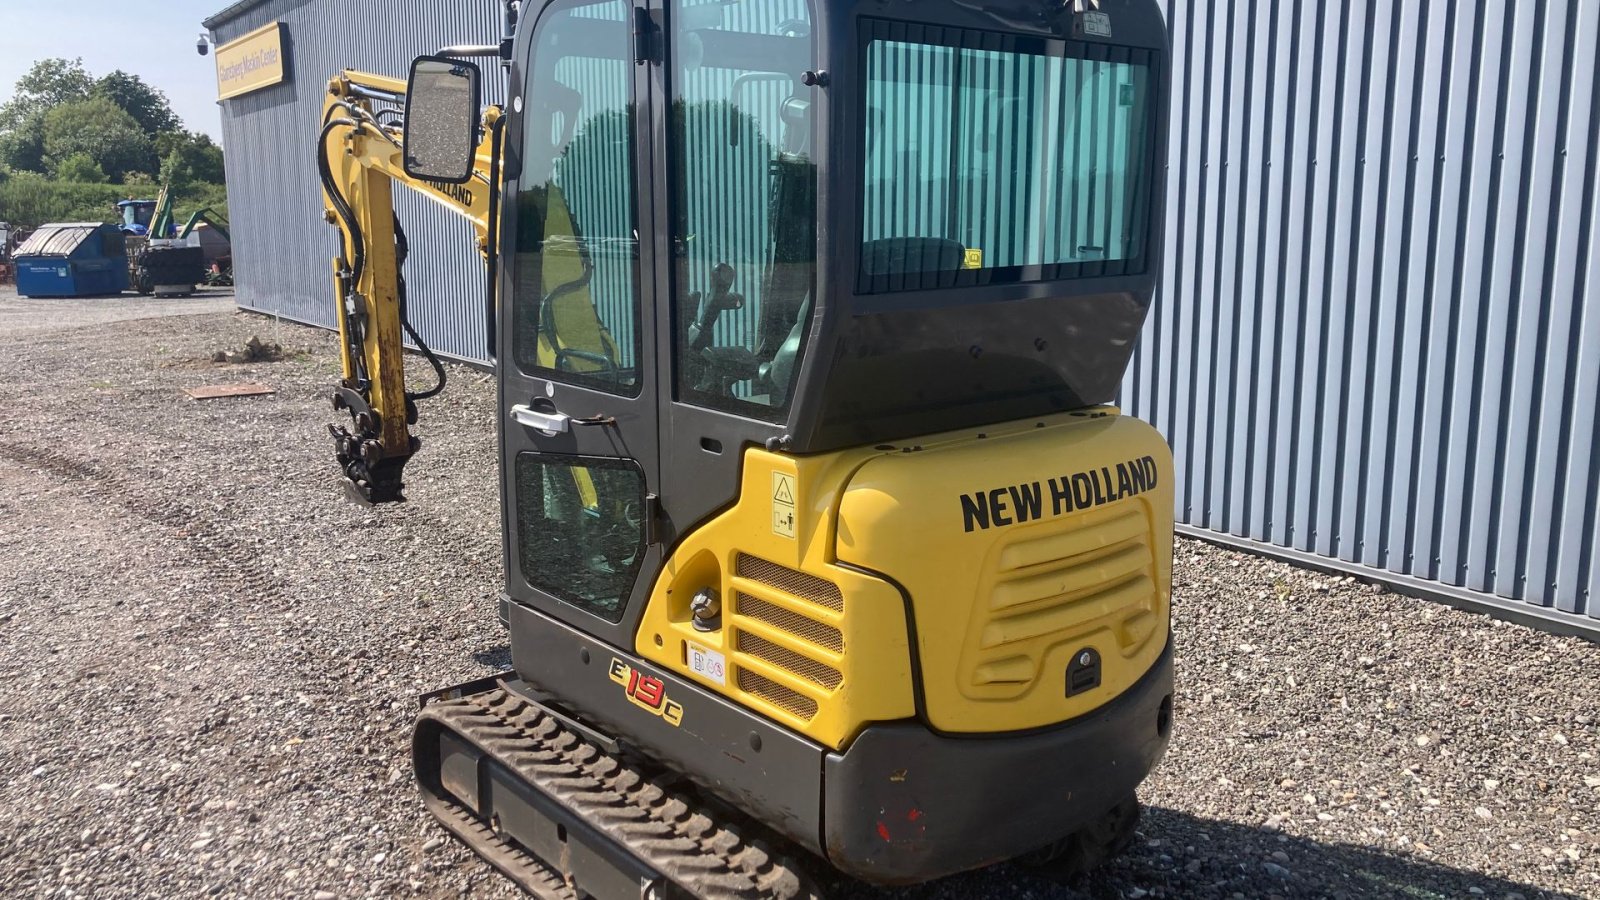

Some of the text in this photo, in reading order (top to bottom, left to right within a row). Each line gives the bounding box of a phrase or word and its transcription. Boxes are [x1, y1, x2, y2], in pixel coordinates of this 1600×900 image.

[261, 48, 278, 67] Center
[959, 455, 1158, 533] NEW HOLLAND
